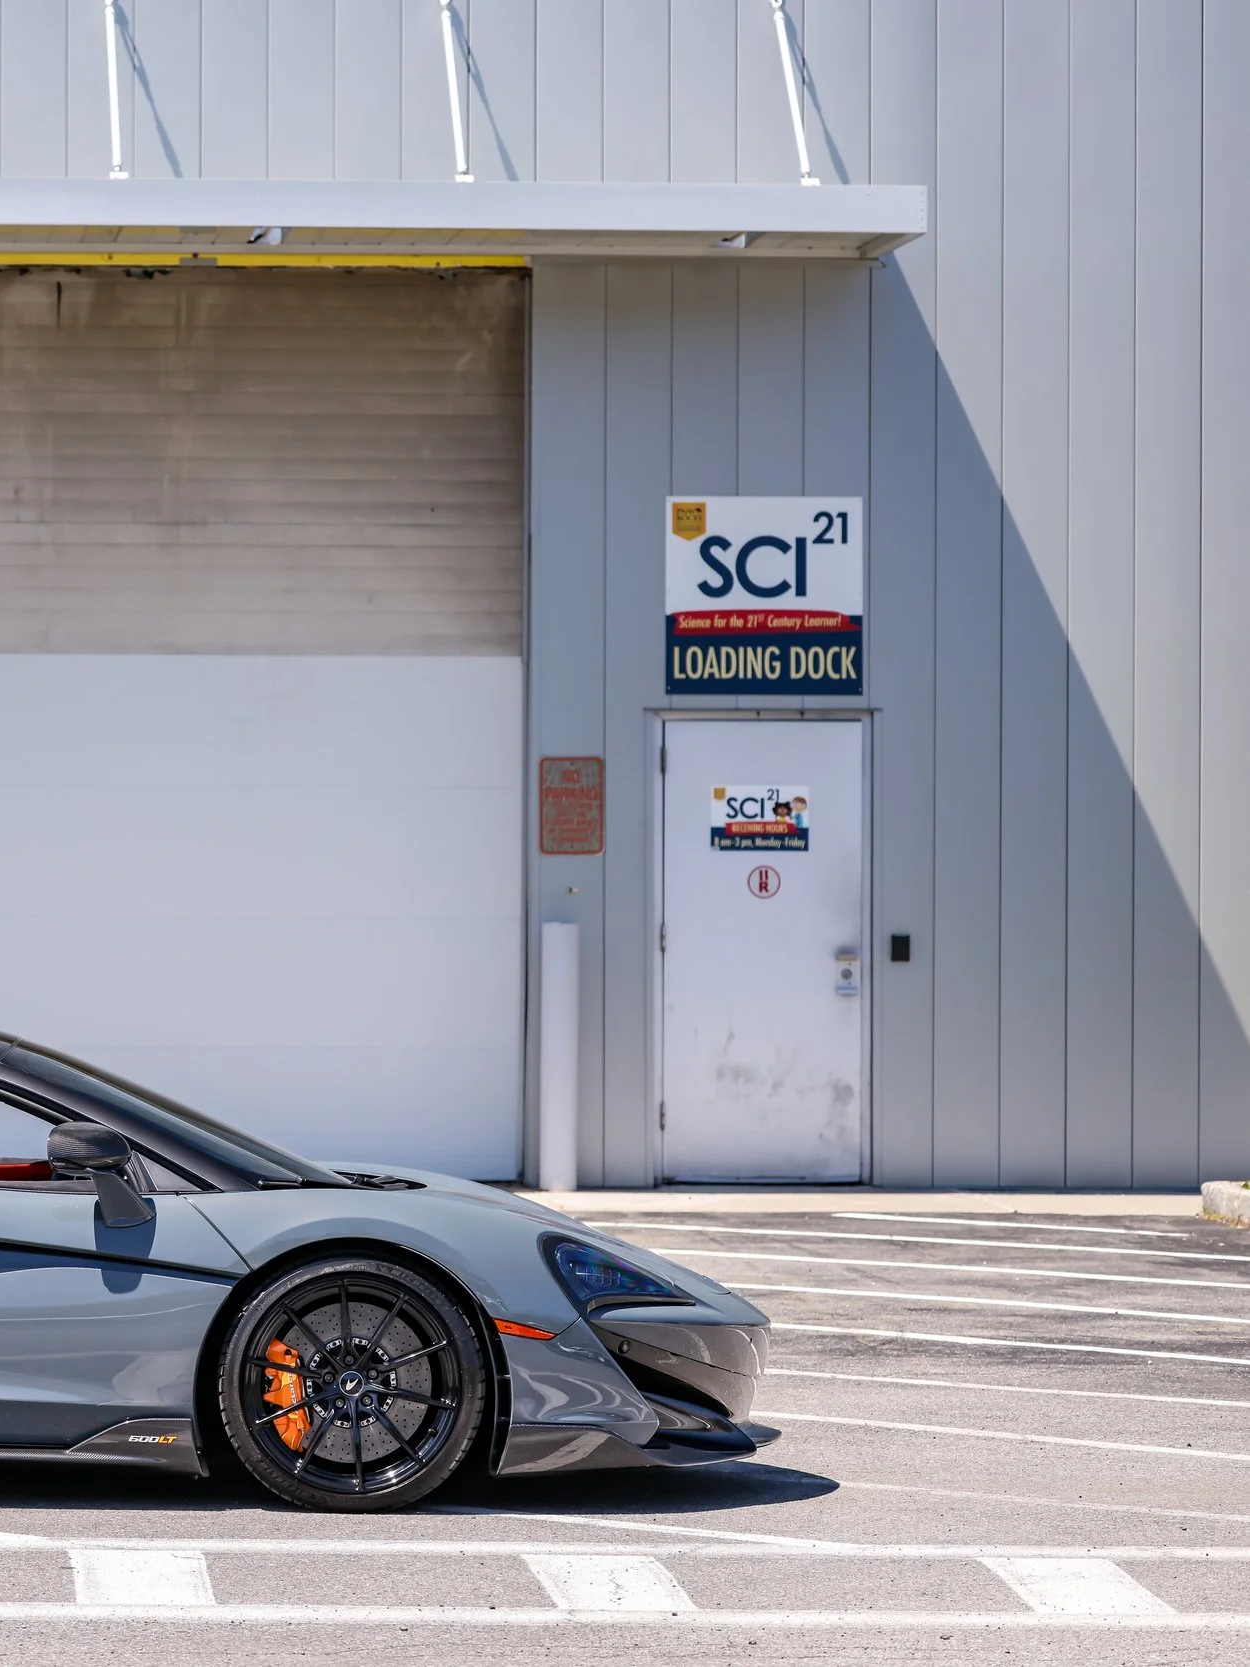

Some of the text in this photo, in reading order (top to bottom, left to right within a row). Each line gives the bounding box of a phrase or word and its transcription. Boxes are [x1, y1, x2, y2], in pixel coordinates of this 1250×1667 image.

[697, 511, 848, 598] SCI 21
[679, 614, 711, 629] Science
[714, 613, 727, 628] for
[730, 613, 744, 628] the
[767, 613, 801, 630] Century
[804, 613, 841, 628] Learner!
[673, 646, 857, 680] LOADING DOCK
[545, 787, 598, 800] PARKING
[726, 788, 780, 819] SCI 21
[732, 823, 788, 833] RECEIVING HOURS
[759, 881, 769, 893] R
[128, 1434, 178, 1443] 600LT
